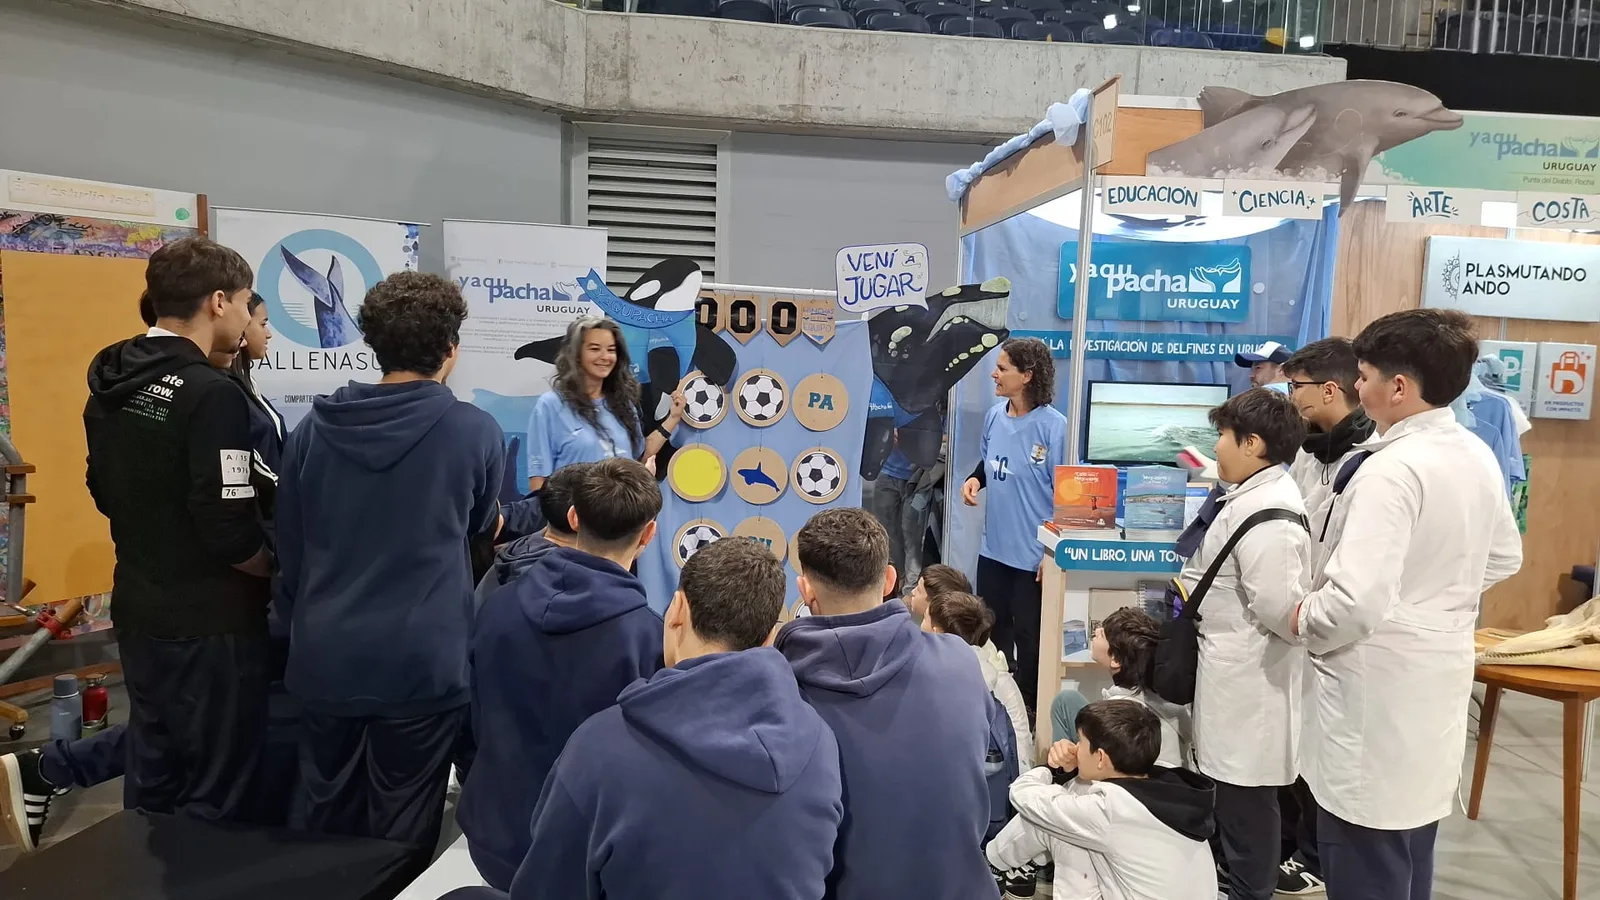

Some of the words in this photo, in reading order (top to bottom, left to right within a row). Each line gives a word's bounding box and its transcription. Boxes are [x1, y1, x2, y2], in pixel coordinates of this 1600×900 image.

[1470, 132, 1518, 147] yaqu
[1497, 138, 1558, 160] pacha
[1543, 162, 1597, 172] URUGUAY
[1108, 185, 1198, 208] EDUCACIÓN
[1238, 189, 1305, 213] CIENCIA
[1412, 191, 1453, 218] ARTE
[1532, 197, 1590, 222] COSTA
[846, 248, 899, 272] VENÍ
[905, 255, 915, 264] A
[1466, 262, 1587, 282] PLASMUTANDO
[459, 276, 507, 288] yaqu
[843, 272, 923, 305] JUGAR
[1106, 269, 1187, 298] pacha
[1462, 281, 1510, 295] ANDO
[489, 283, 550, 303] pacha
[536, 305, 591, 314] URUGUAY
[1167, 298, 1239, 309] URUGUAY
[1050, 339, 1064, 350] LA
[1069, 339, 1147, 353] IVESTIGACIÓN
[1152, 342, 1164, 354] DE
[1167, 342, 1215, 355] DELFINES
[1219, 344, 1234, 355] EN
[162, 374, 184, 387] ate
[808, 392, 834, 410] PA
[1092, 549, 1127, 562] LIBRO,
[1131, 549, 1155, 562] UNA
